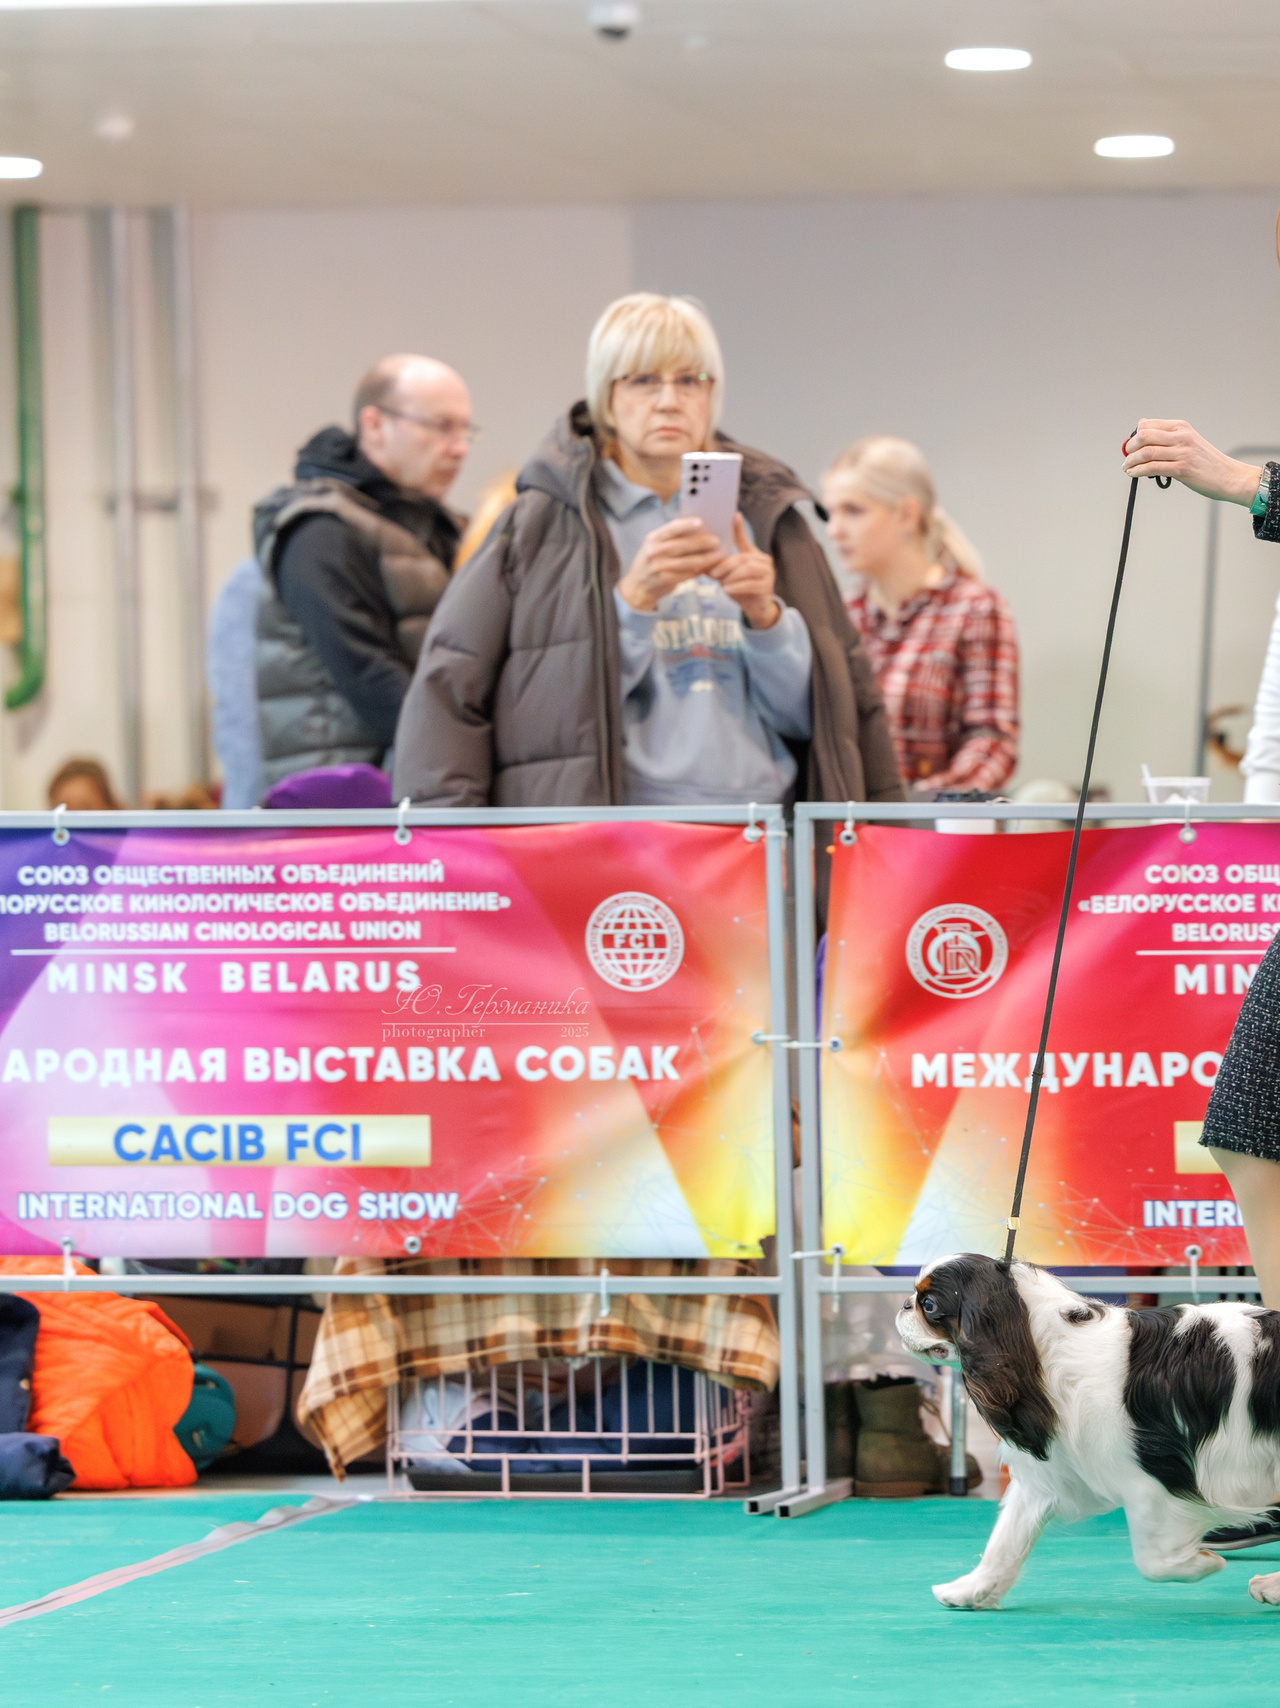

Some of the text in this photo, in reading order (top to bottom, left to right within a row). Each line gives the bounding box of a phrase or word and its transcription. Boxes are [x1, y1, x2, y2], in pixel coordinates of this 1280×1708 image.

[17, 859, 444, 887] СОЮЗ ОБЩЕСТВЕННЫХ ОБЪЕДИНЕНИЙ
[1145, 864, 1219, 884] СОЮЗ
[129, 892, 334, 913] КИНОЛОГИЧЕСКОЕ
[339, 891, 512, 913] ОБЪЕДИНЕНИЕ»
[1077, 894, 1256, 914] «БЕЛОРУССКОЕ
[43, 920, 421, 942] BELORUSSIAN CINOLOGICAL UNION
[613, 933, 655, 949] FCI
[47, 959, 422, 993] MINSK BELARUS
[1, 1045, 680, 1089] АРОДНАЯ ВЫСТАВКА СОБАК
[112, 1123, 361, 1162] CACIB FCI
[17, 1191, 459, 1220] INTERNATIONAL DOG SHOW
